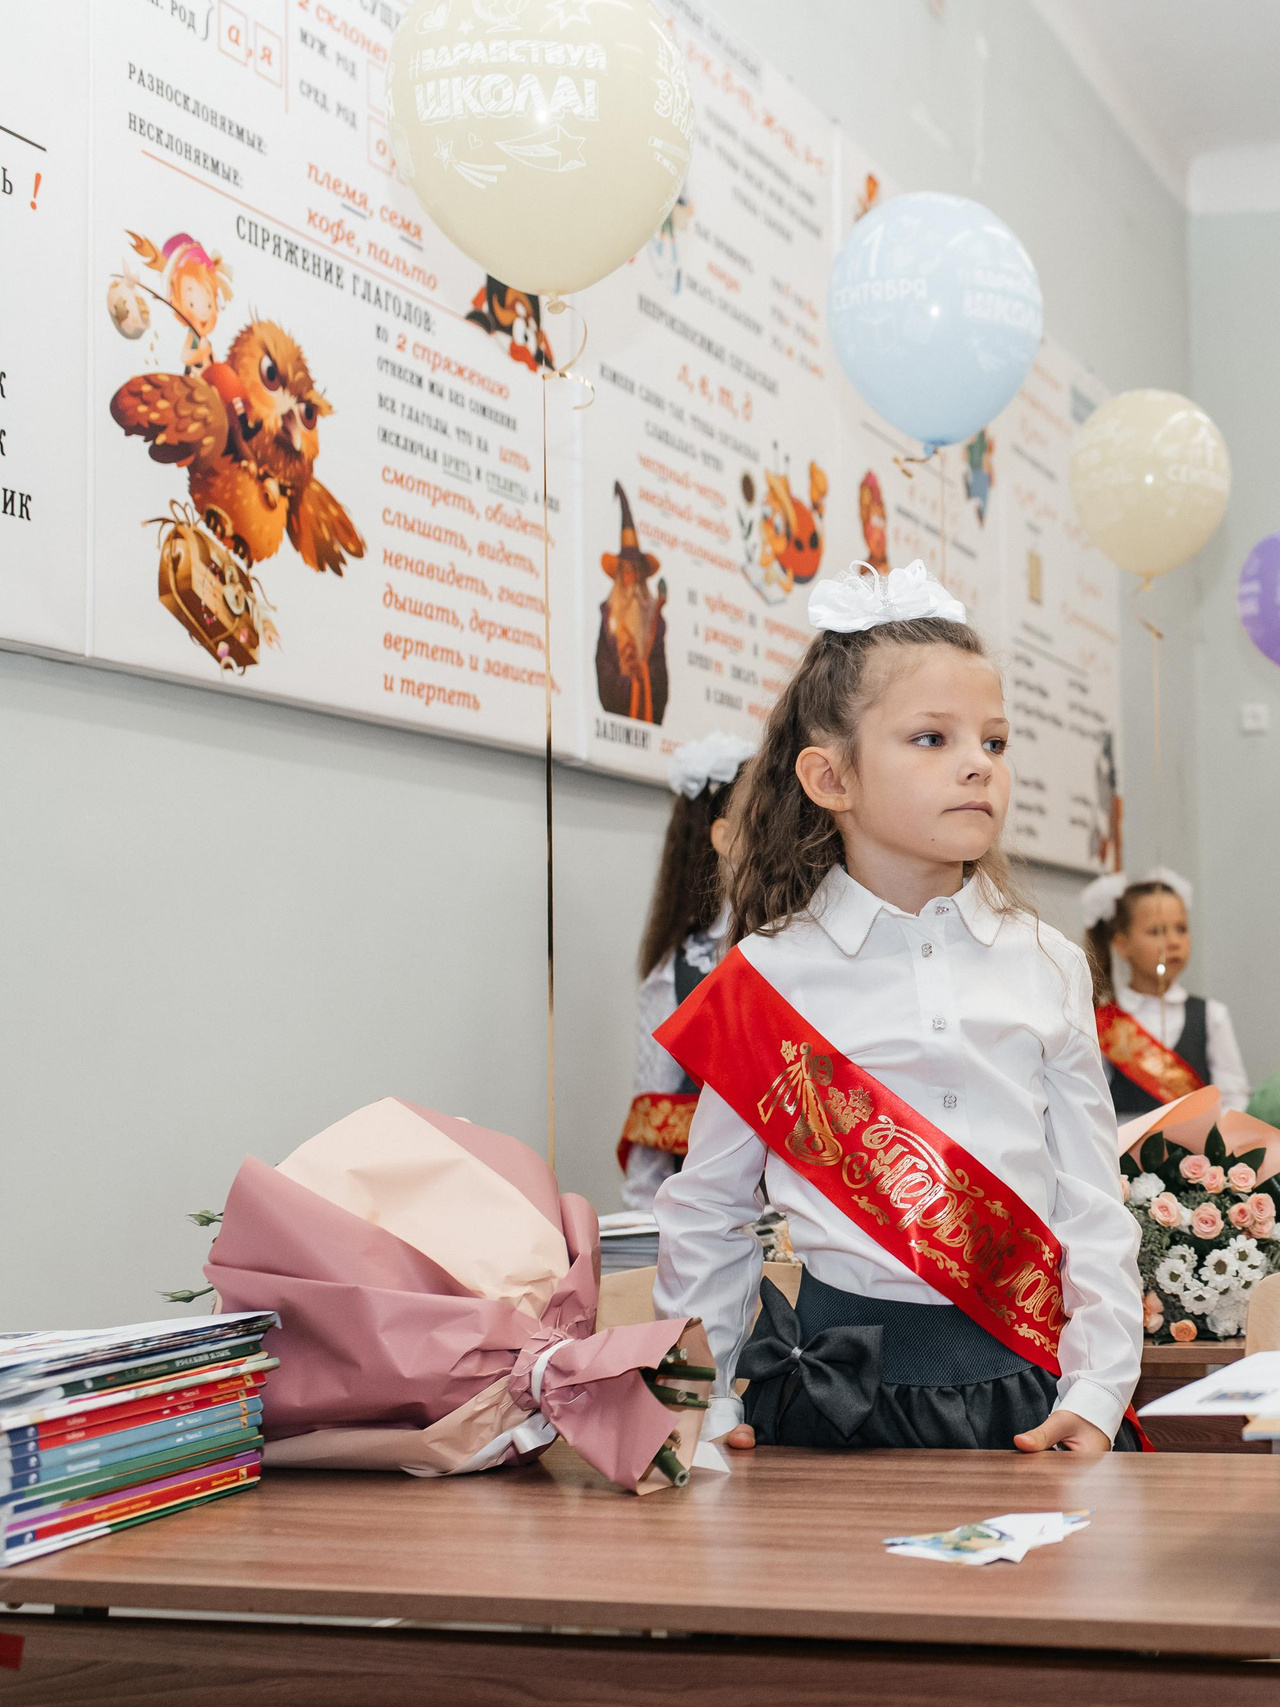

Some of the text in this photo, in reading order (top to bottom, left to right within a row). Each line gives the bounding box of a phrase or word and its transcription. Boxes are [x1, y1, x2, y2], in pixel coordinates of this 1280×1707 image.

[127, 62, 269, 156] РАЗНОСКЛОНЯЕМЫЕ:
[127, 112, 244, 189] НЕСКЛОНЯЕМЫЕ:
[235, 214, 437, 336] СПРЯЖЕНИЕ ГЛАГОЛОВ:
[307, 206, 439, 293] кофе, пальто
[381, 464, 481, 522] смотреть,
[381, 506, 473, 557] слышать,
[382, 547, 493, 602] ненавидеть,
[382, 582, 465, 633] дышать,
[383, 631, 465, 669] вертеть
[468, 654, 480, 673] и
[383, 672, 482, 713] и терпеть
